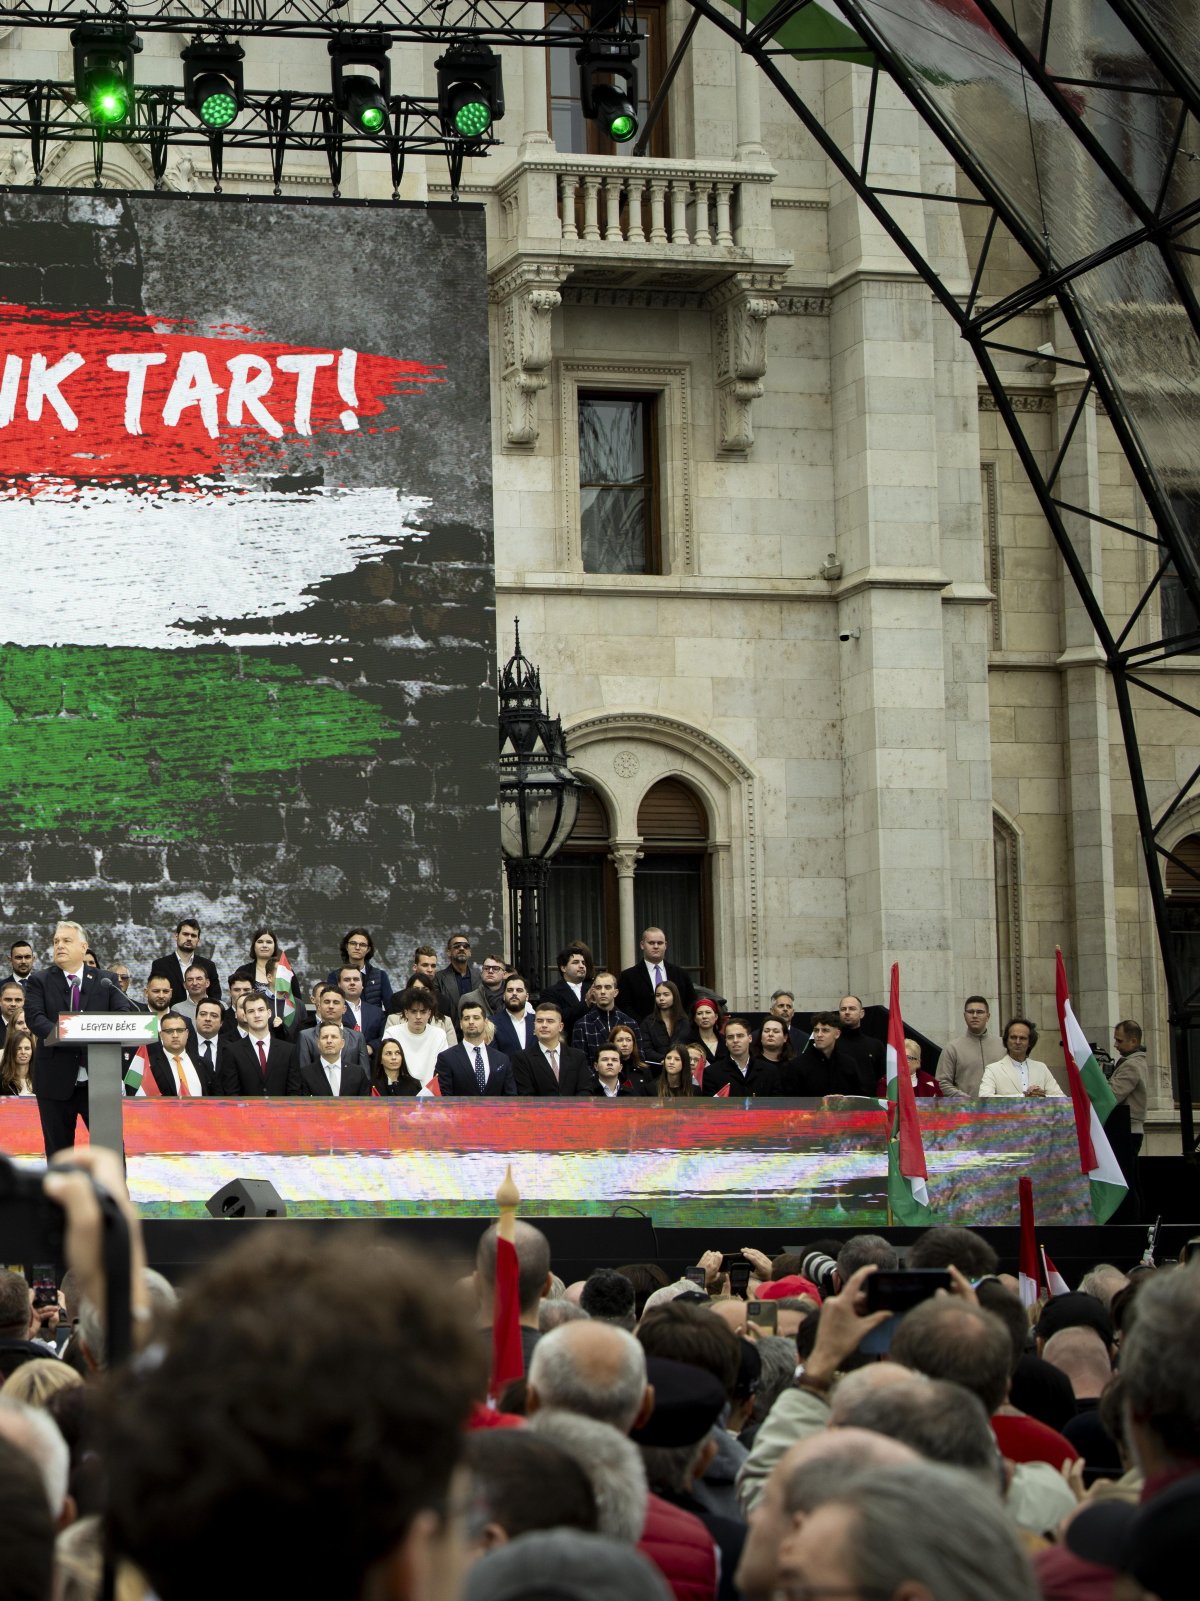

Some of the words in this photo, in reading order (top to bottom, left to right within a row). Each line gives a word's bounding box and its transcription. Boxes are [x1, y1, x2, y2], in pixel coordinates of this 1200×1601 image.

[106, 347, 360, 439] TART!
[80, 1022, 113, 1031] LEGYEN
[115, 1020, 137, 1031] BÉKE
